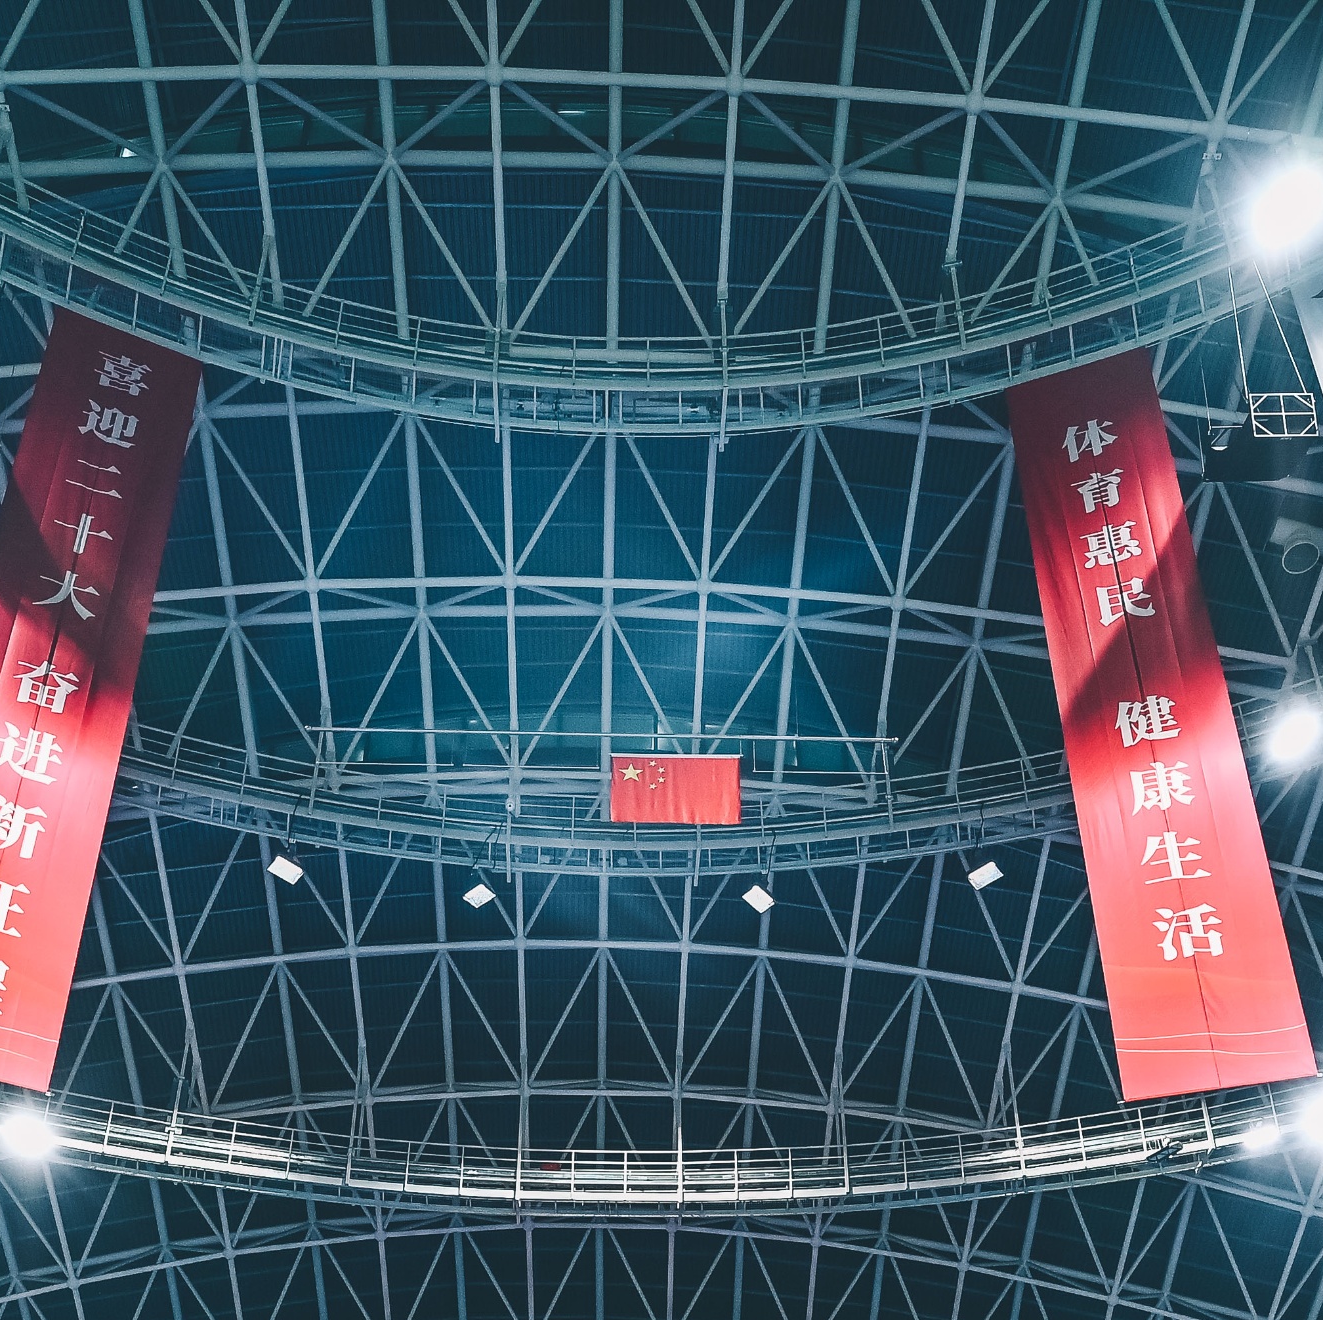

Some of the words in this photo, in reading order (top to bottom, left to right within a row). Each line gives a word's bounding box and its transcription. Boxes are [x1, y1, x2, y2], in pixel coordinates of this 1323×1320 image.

[32, 348, 153, 622] 喜迎二十大
[1061, 418, 1157, 629] 体育惠民
[1114, 698, 1226, 962] 健康生活
